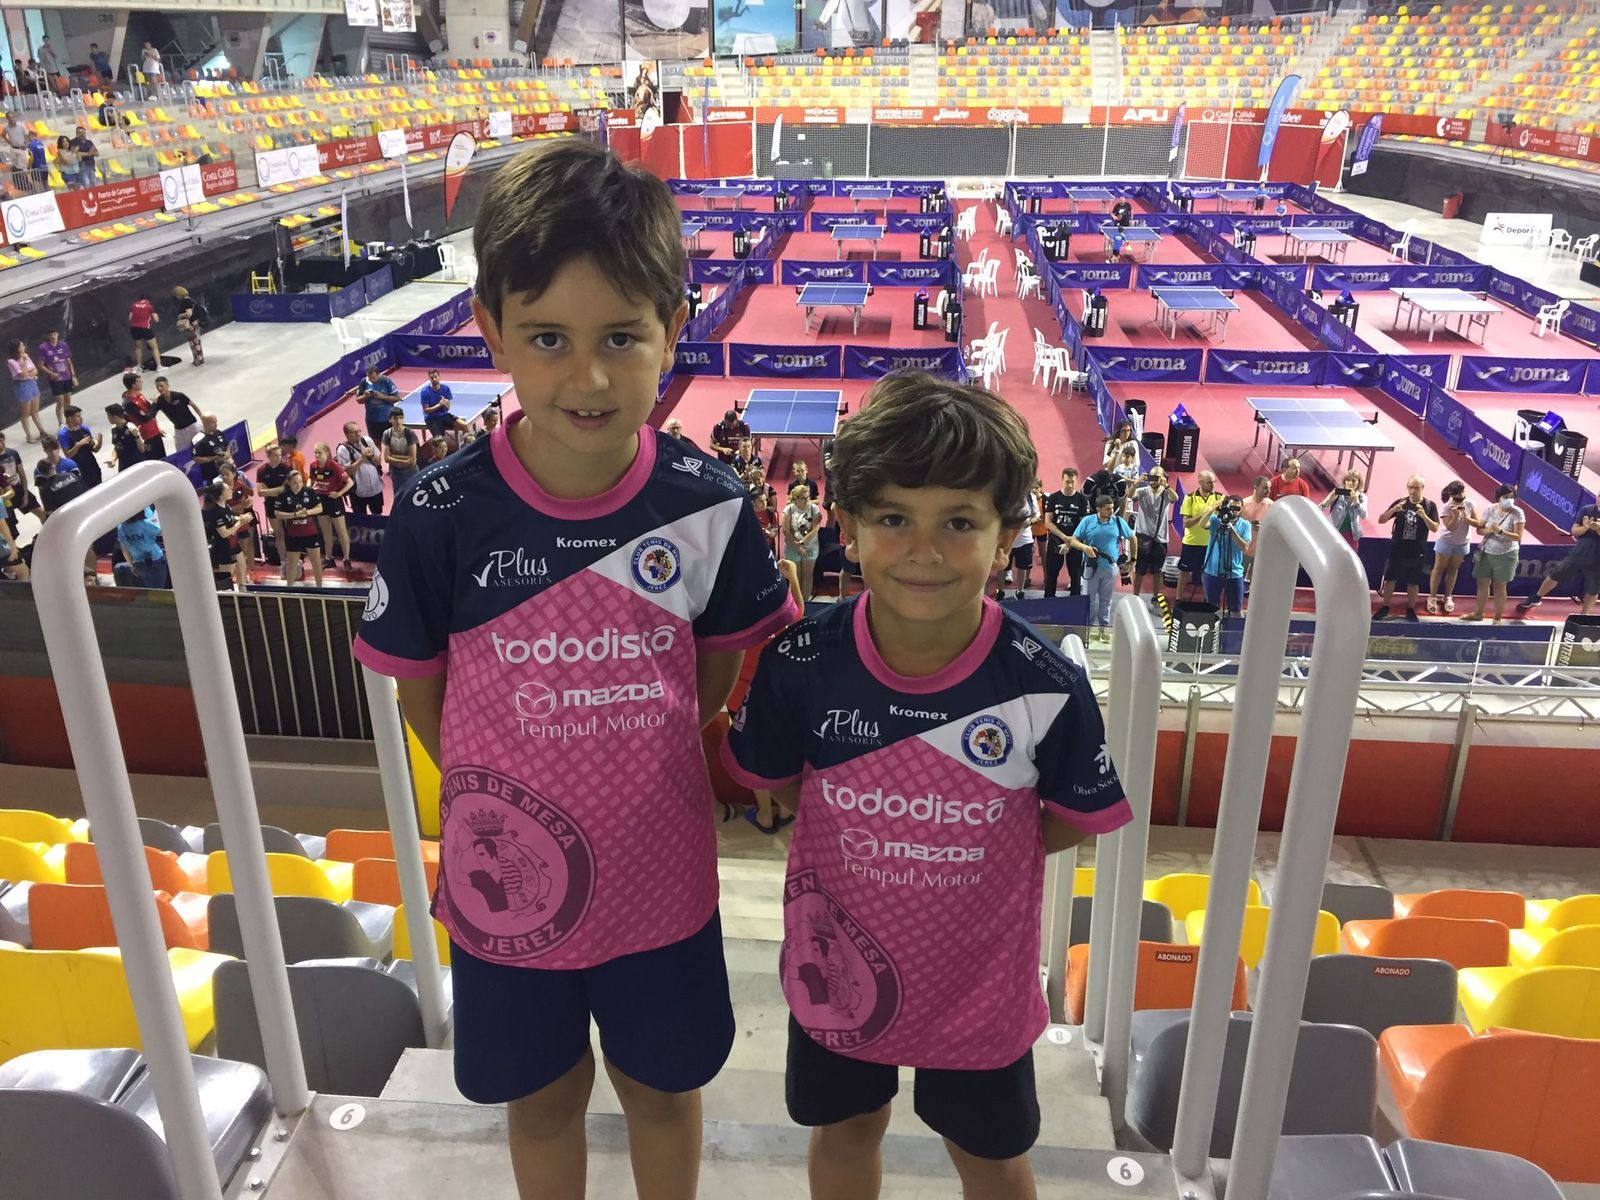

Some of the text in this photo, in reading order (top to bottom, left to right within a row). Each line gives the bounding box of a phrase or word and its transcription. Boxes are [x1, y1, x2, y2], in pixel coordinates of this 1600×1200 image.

[556, 537, 617, 549] Kromex
[489, 547, 550, 579] Plus
[493, 576, 552, 588] ASESORES
[827, 709, 882, 738] Plus
[889, 705, 949, 721] Kromex
[515, 711, 668, 743] Tempul Motor
[487, 776, 514, 801] DE
[519, 797, 577, 850] MESA
[841, 854, 984, 888] Tempul Motor
[481, 922, 562, 954] JEREZ
[841, 919, 888, 975] MESA
[1157, 953, 1192, 962] ABONADO
[1374, 967, 1410, 976] ABONADO
[340, 1108, 355, 1125] 6
[1119, 1161, 1132, 1180] 6
